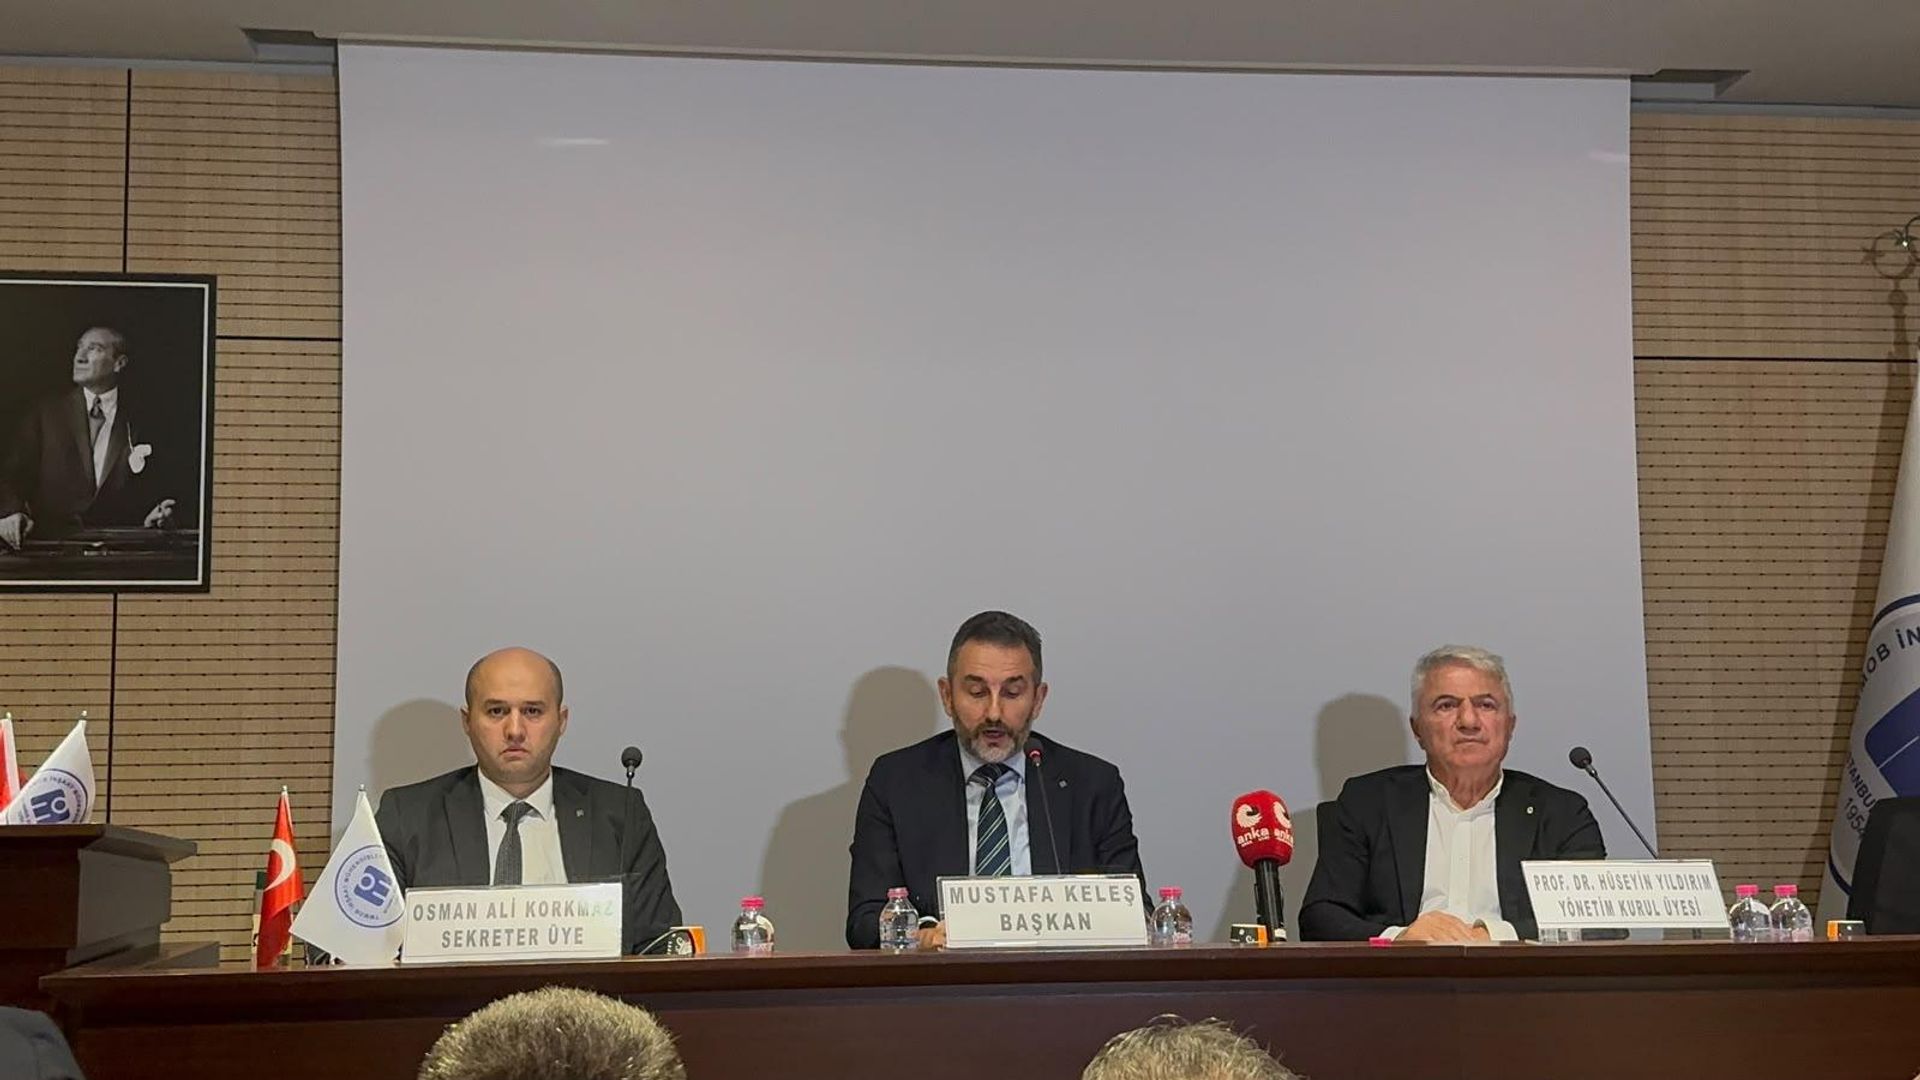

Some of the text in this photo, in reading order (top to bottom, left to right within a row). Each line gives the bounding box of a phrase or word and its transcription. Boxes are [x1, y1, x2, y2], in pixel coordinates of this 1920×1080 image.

[1237, 827, 1270, 845] anka
[1533, 870, 1713, 892] PROF. DR. HÜSEYİN YILDIRIM
[950, 884, 1136, 906] MUSTAFA KELEŞ
[413, 897, 614, 921] OSMAN ALİ KORKMAZ
[1558, 896, 1702, 917] YÖNETİM KURUL ÜYESİ
[1000, 912, 1092, 935] BAŞKAN
[441, 923, 584, 948] SEKRETER ÜYE
